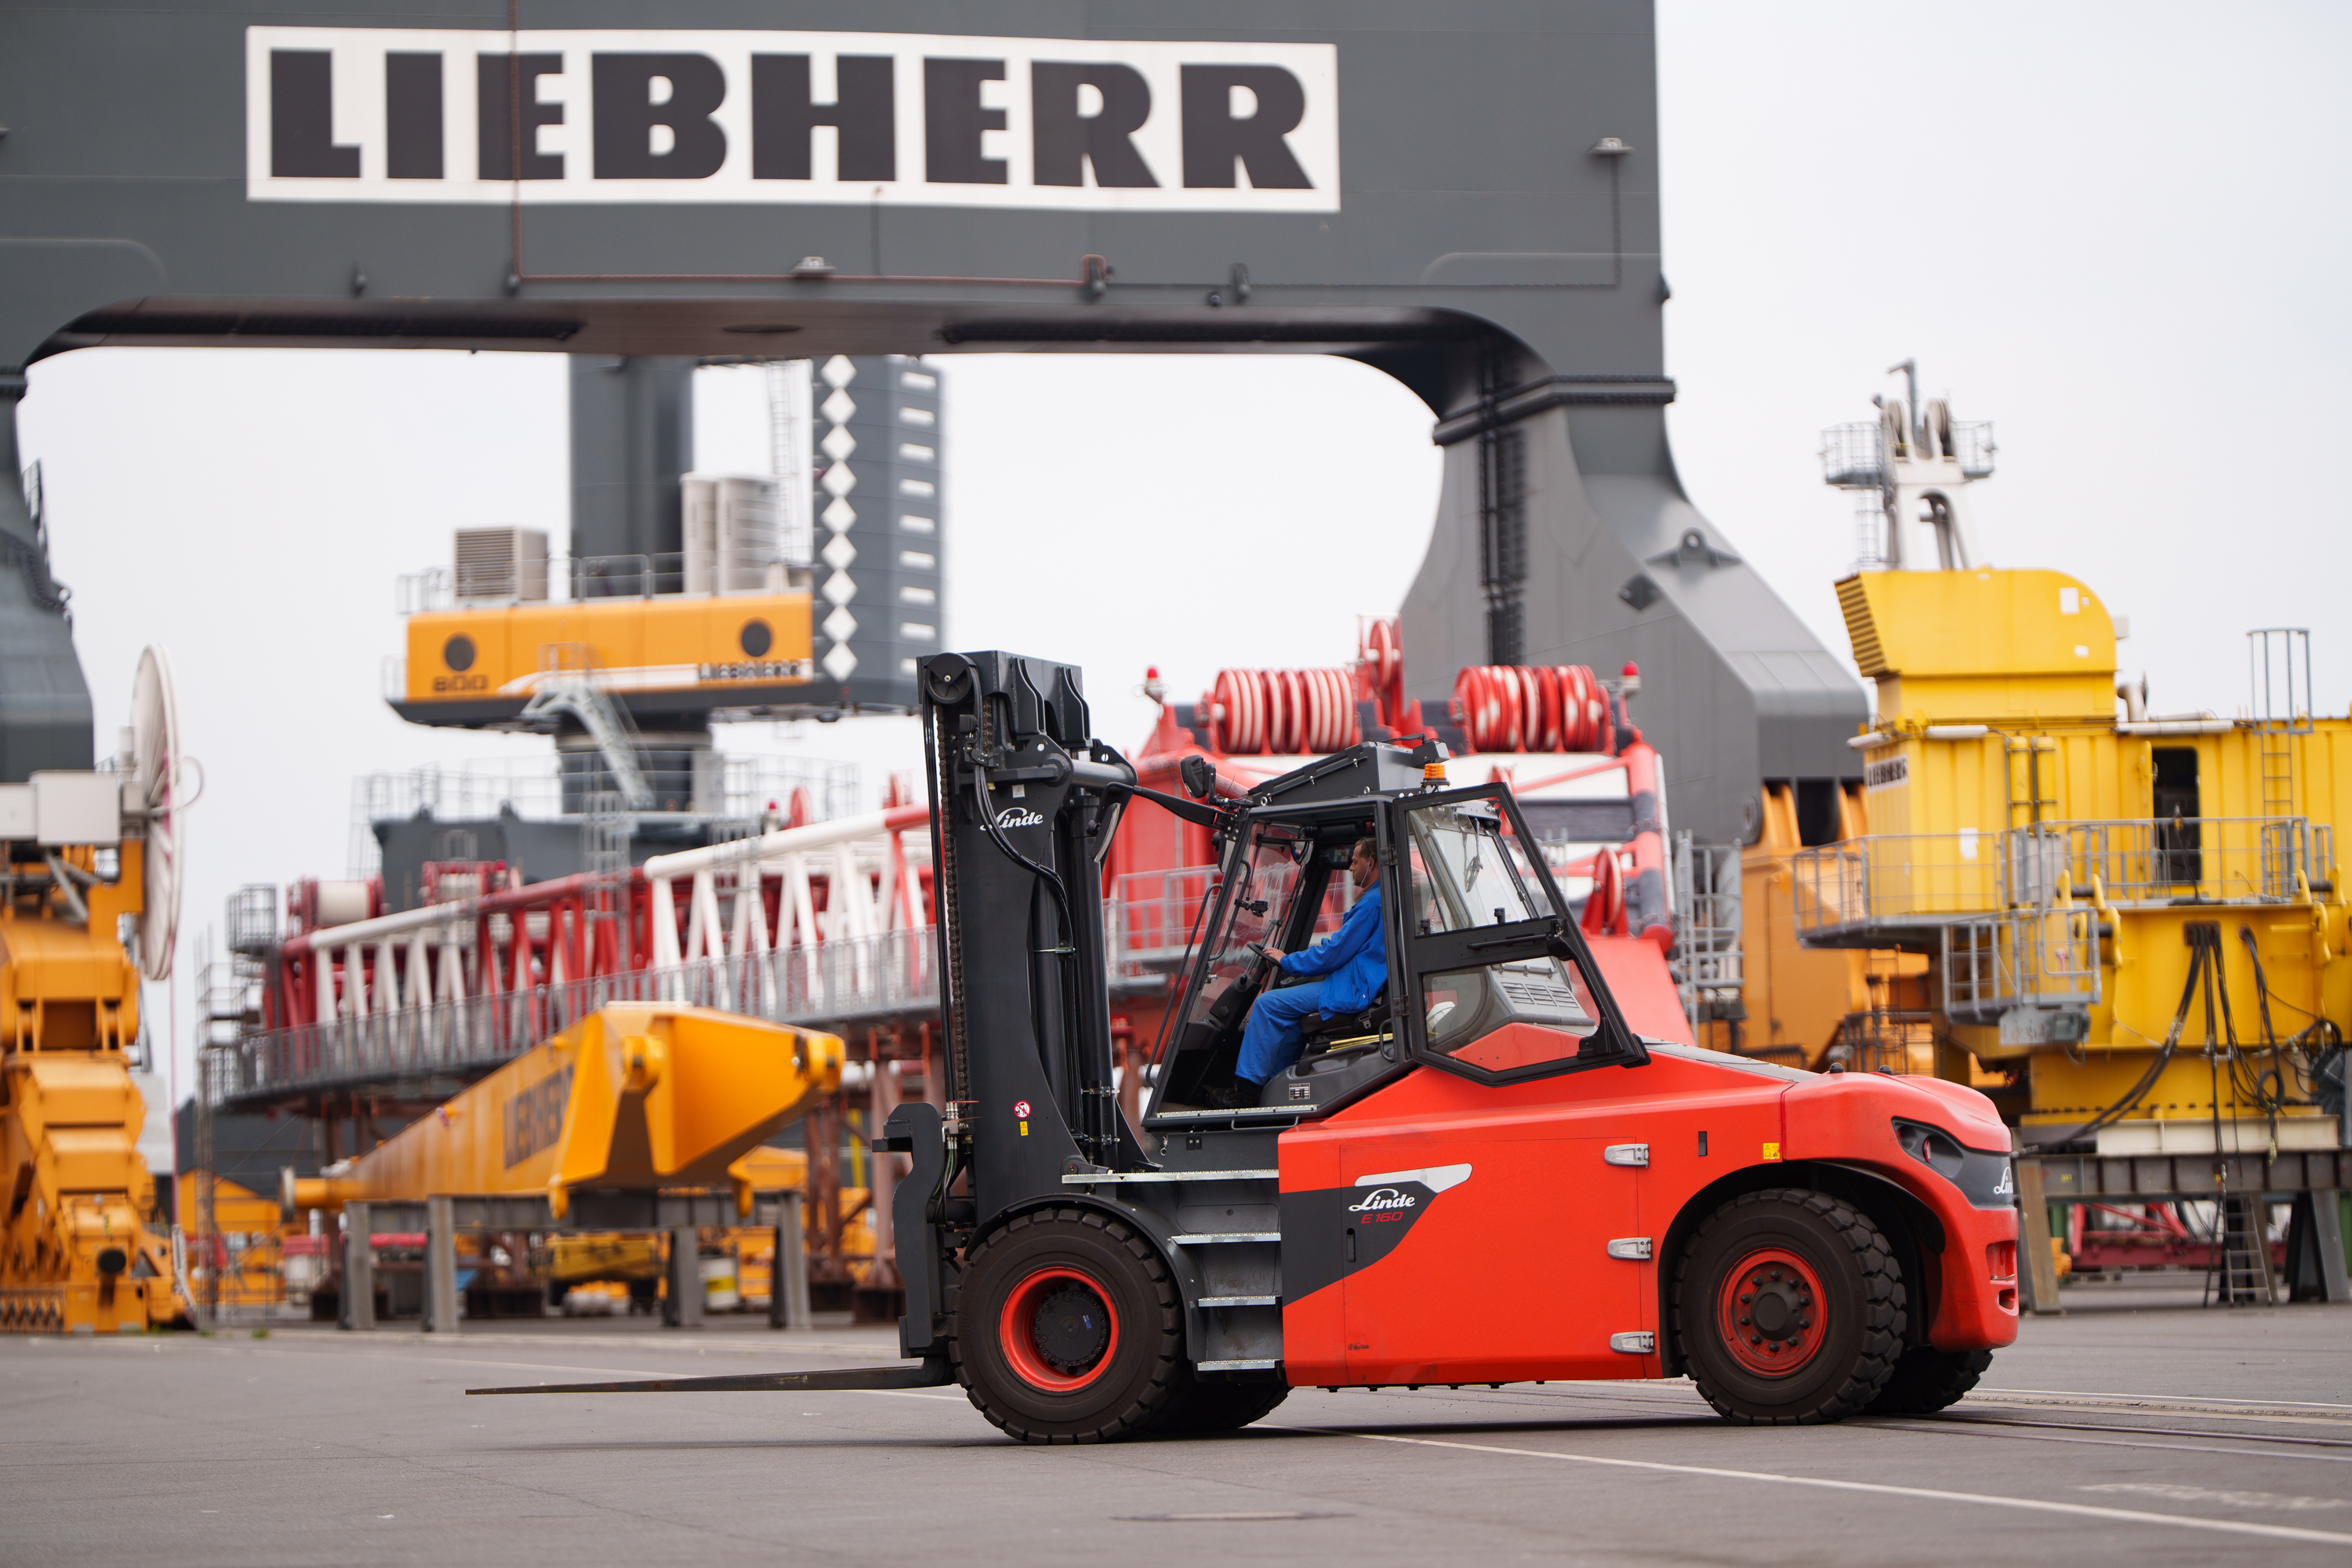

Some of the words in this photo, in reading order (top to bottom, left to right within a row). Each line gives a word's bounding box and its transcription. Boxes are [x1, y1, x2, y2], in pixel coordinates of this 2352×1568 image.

[270, 49, 1316, 190] LIEBHERR
[979, 807, 1044, 831] Linde
[1348, 1188, 1416, 1212] Linde
[1361, 1214, 1374, 1224] E
[1375, 1211, 1403, 1223] 160
